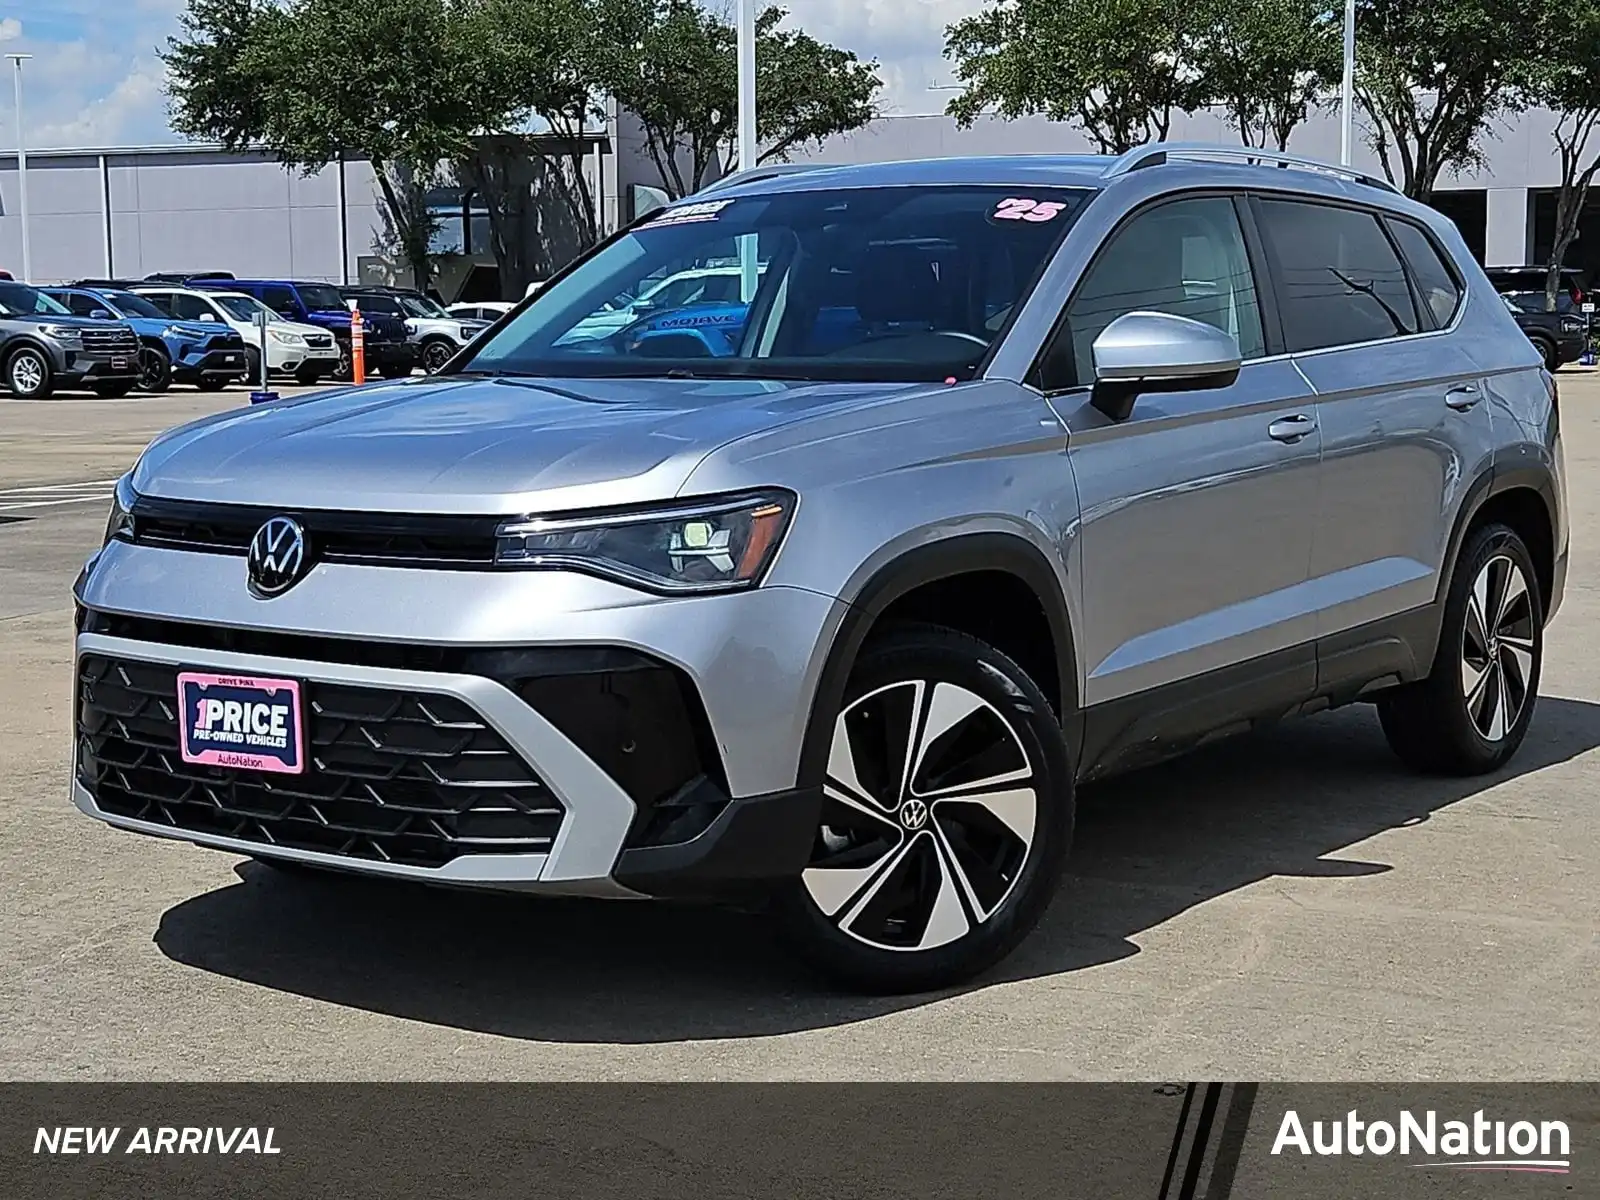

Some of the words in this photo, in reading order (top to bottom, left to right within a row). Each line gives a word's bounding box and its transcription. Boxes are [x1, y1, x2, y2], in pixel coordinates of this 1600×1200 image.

[195, 698, 289, 737] 1PRICE
[193, 729, 244, 743] PRE-OWNED
[246, 734, 287, 748] VEHICLES
[217, 754, 263, 767] AutoNation
